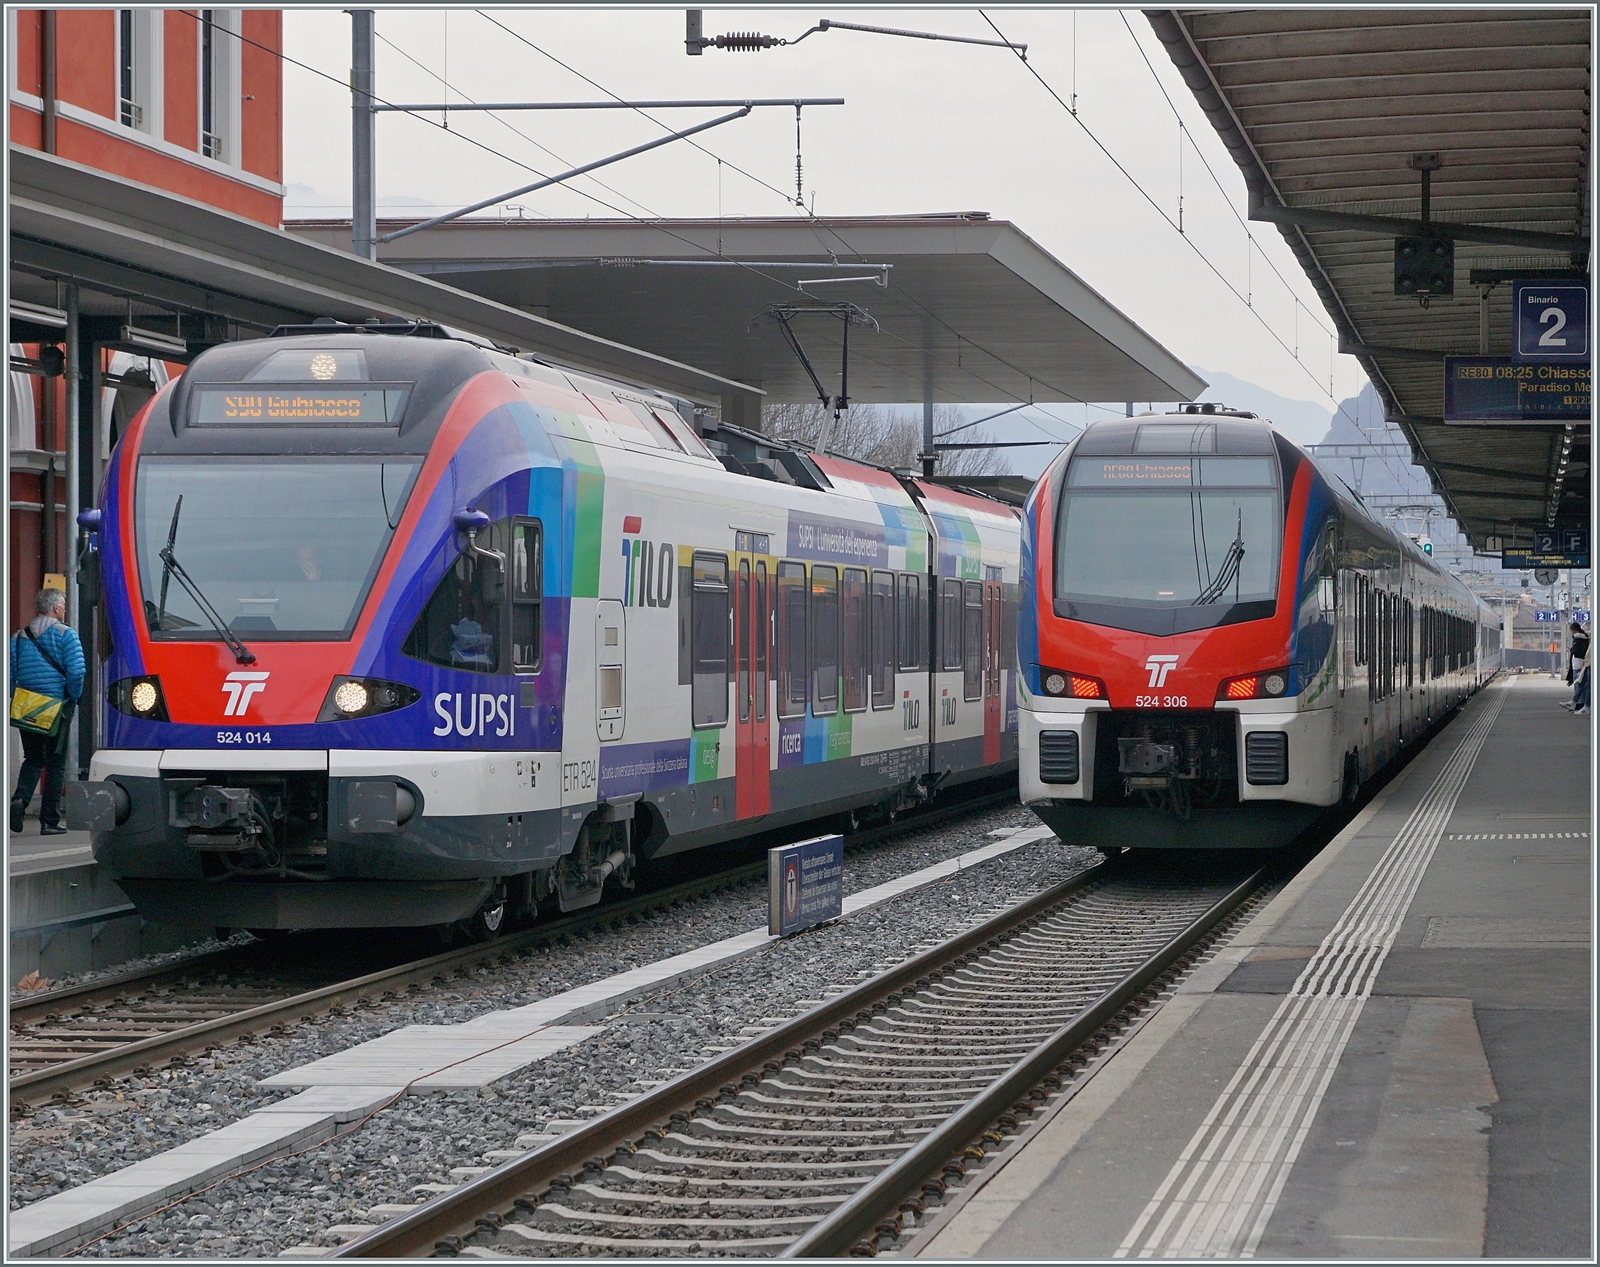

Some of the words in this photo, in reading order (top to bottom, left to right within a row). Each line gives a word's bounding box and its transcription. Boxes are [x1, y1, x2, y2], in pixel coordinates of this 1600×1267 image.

[1528, 296, 1559, 304] Binario
[1538, 307, 1567, 347] 2
[1459, 367, 1490, 379] RE80
[1496, 366, 1533, 379] 08:25
[1520, 382, 1571, 392] Paradiso
[1542, 537, 1552, 551] 2
[1570, 537, 1580, 551] F
[729, 607, 734, 645] 1
[770, 610, 775, 646] 1
[1135, 695, 1159, 708] 524
[1163, 695, 1188, 708] 306
[433, 692, 515, 737] SUPSI
[216, 731, 242, 744] 524
[245, 731, 272, 744] 014
[782, 727, 801, 755] ricerca
[563, 762, 579, 792] ETR
[581, 760, 597, 789] 524
